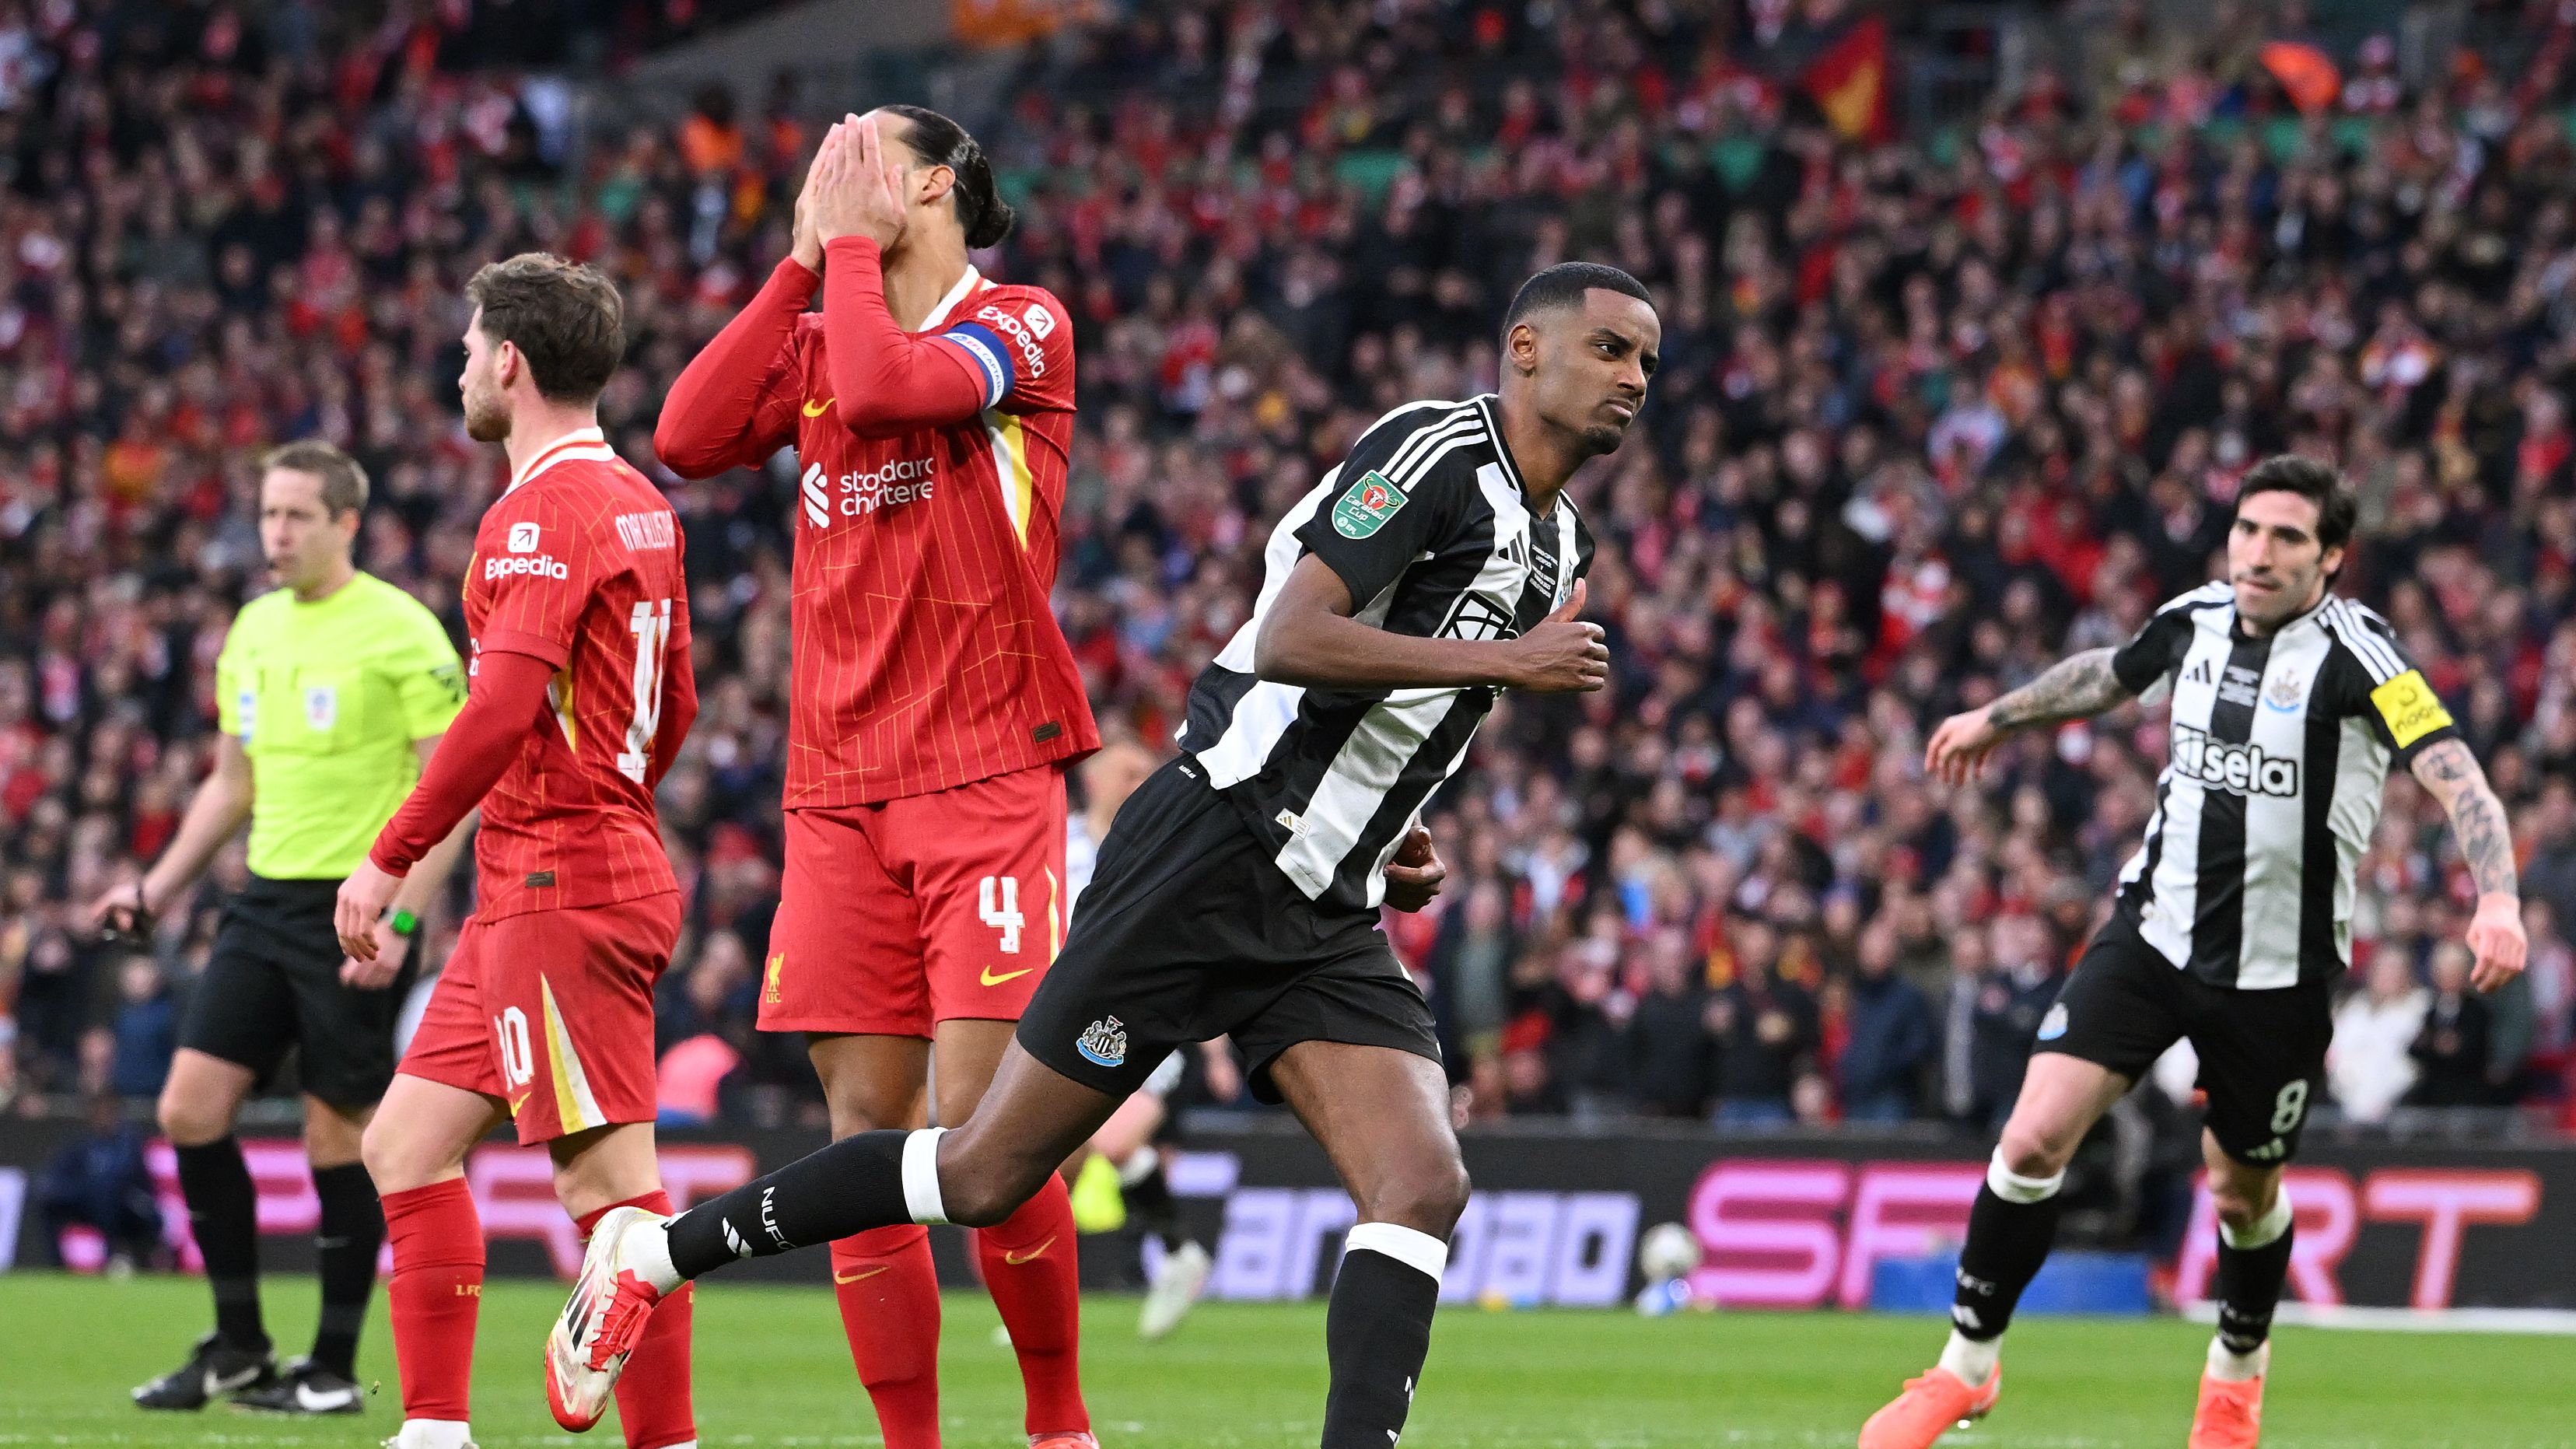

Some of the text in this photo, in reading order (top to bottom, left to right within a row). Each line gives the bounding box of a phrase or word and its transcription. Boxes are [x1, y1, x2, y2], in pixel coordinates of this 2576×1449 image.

[977, 306, 1045, 378] Expedia
[1345, 495, 1385, 520] Carabao
[1348, 506, 1369, 521] Cup
[979, 876, 1025, 954] 4
[2270, 1079, 2308, 1134] 8
[761, 1186, 797, 1250] NUFC
